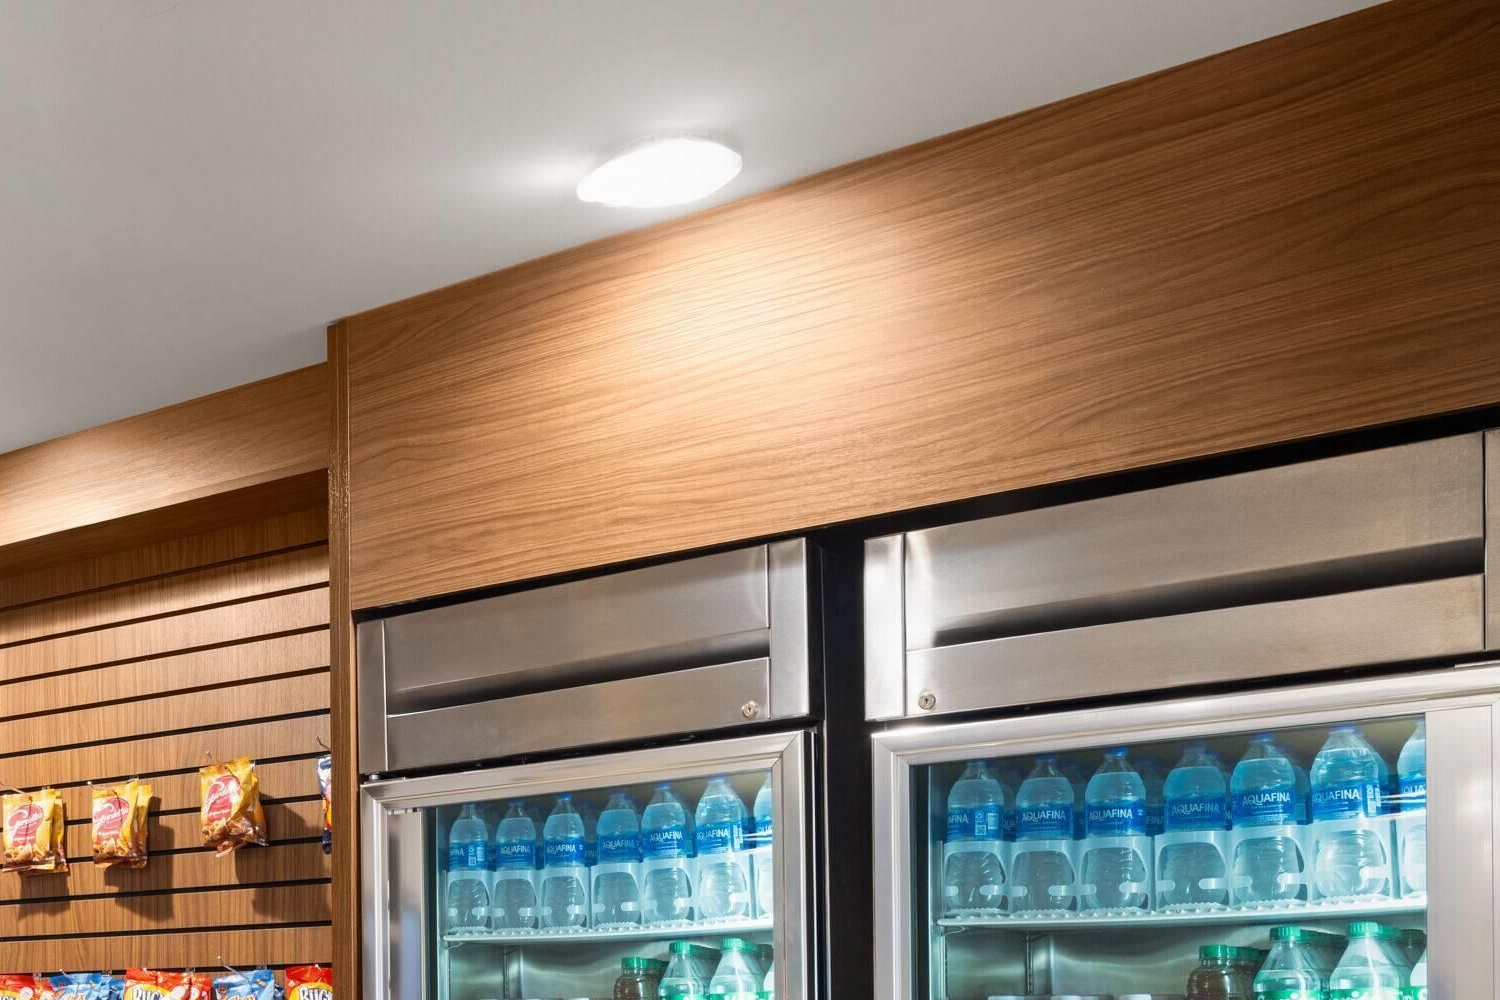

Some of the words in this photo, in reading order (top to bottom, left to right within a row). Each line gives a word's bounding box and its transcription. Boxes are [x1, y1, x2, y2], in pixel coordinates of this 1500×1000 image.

[1242, 791, 1291, 806] AQUAFINA
[1089, 808, 1133, 822] AQUAFINA
[1171, 802, 1219, 815] AQUAFINA
[1021, 810, 1066, 824] AQUAFINA
[650, 830, 683, 843] AQUAFINA
